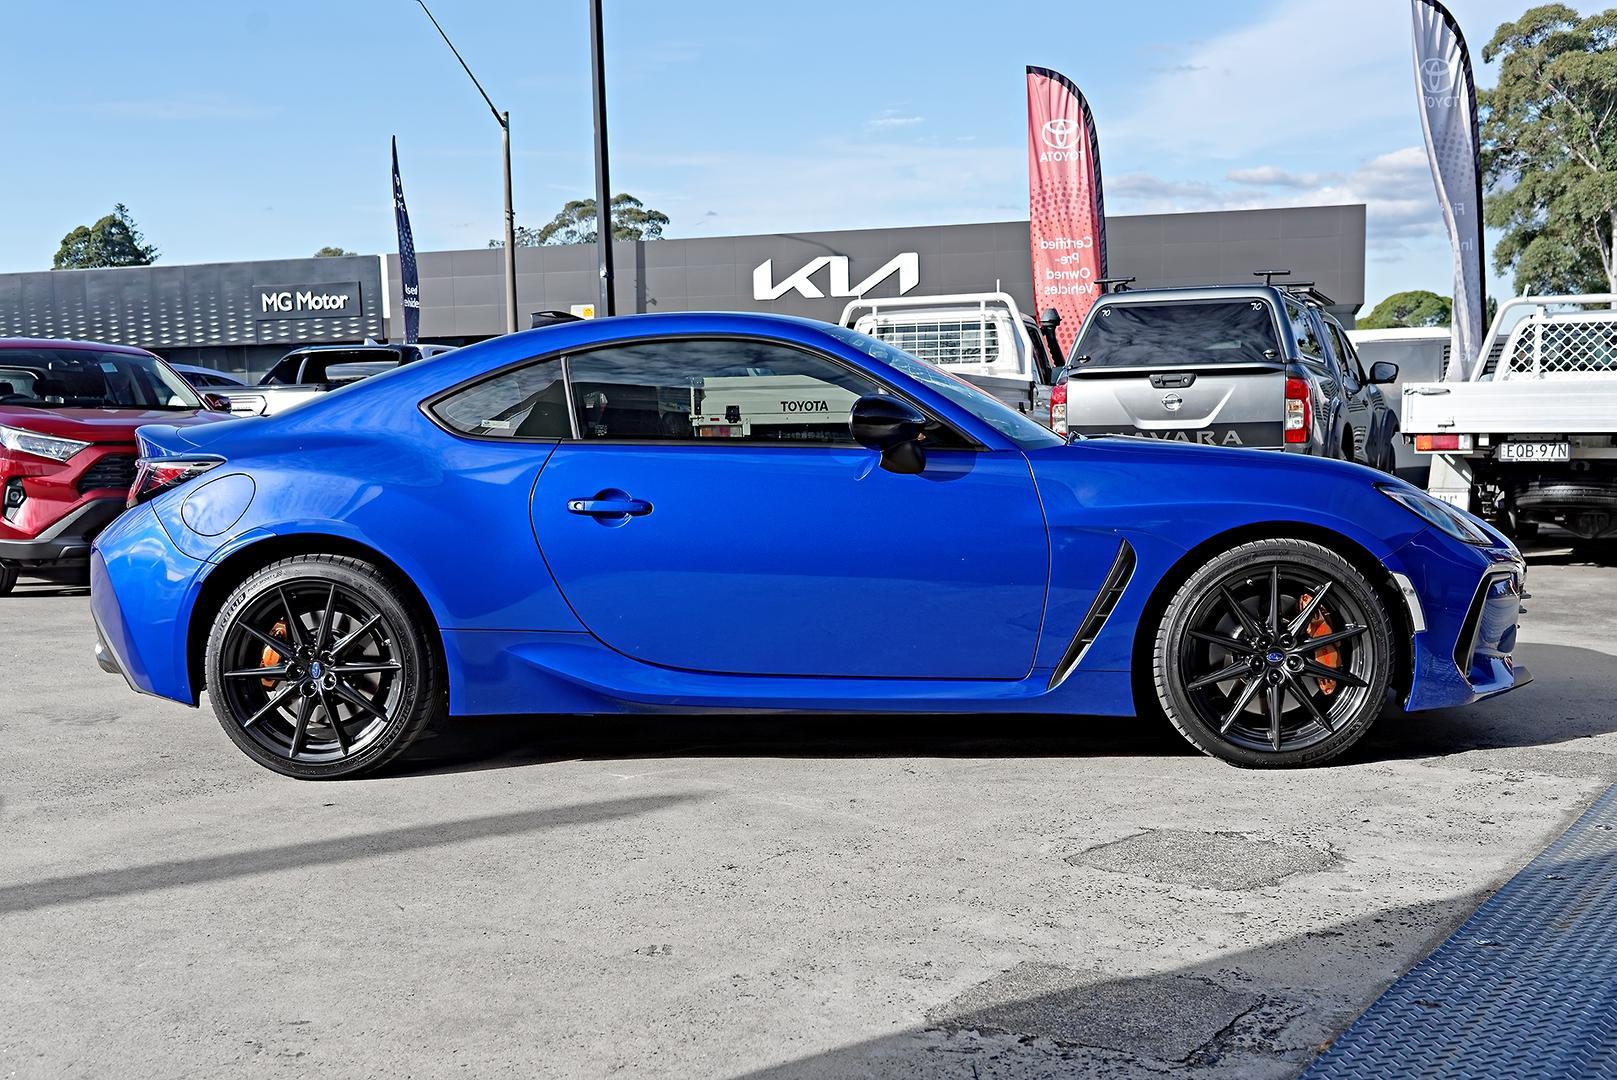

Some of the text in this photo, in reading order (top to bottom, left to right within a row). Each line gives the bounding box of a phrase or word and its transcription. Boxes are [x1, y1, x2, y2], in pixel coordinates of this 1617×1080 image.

[753, 252, 919, 300] KIA
[261, 290, 349, 312] MG Motor
[780, 400, 829, 412] TOYOTA
[1107, 430, 1244, 445] VARA
